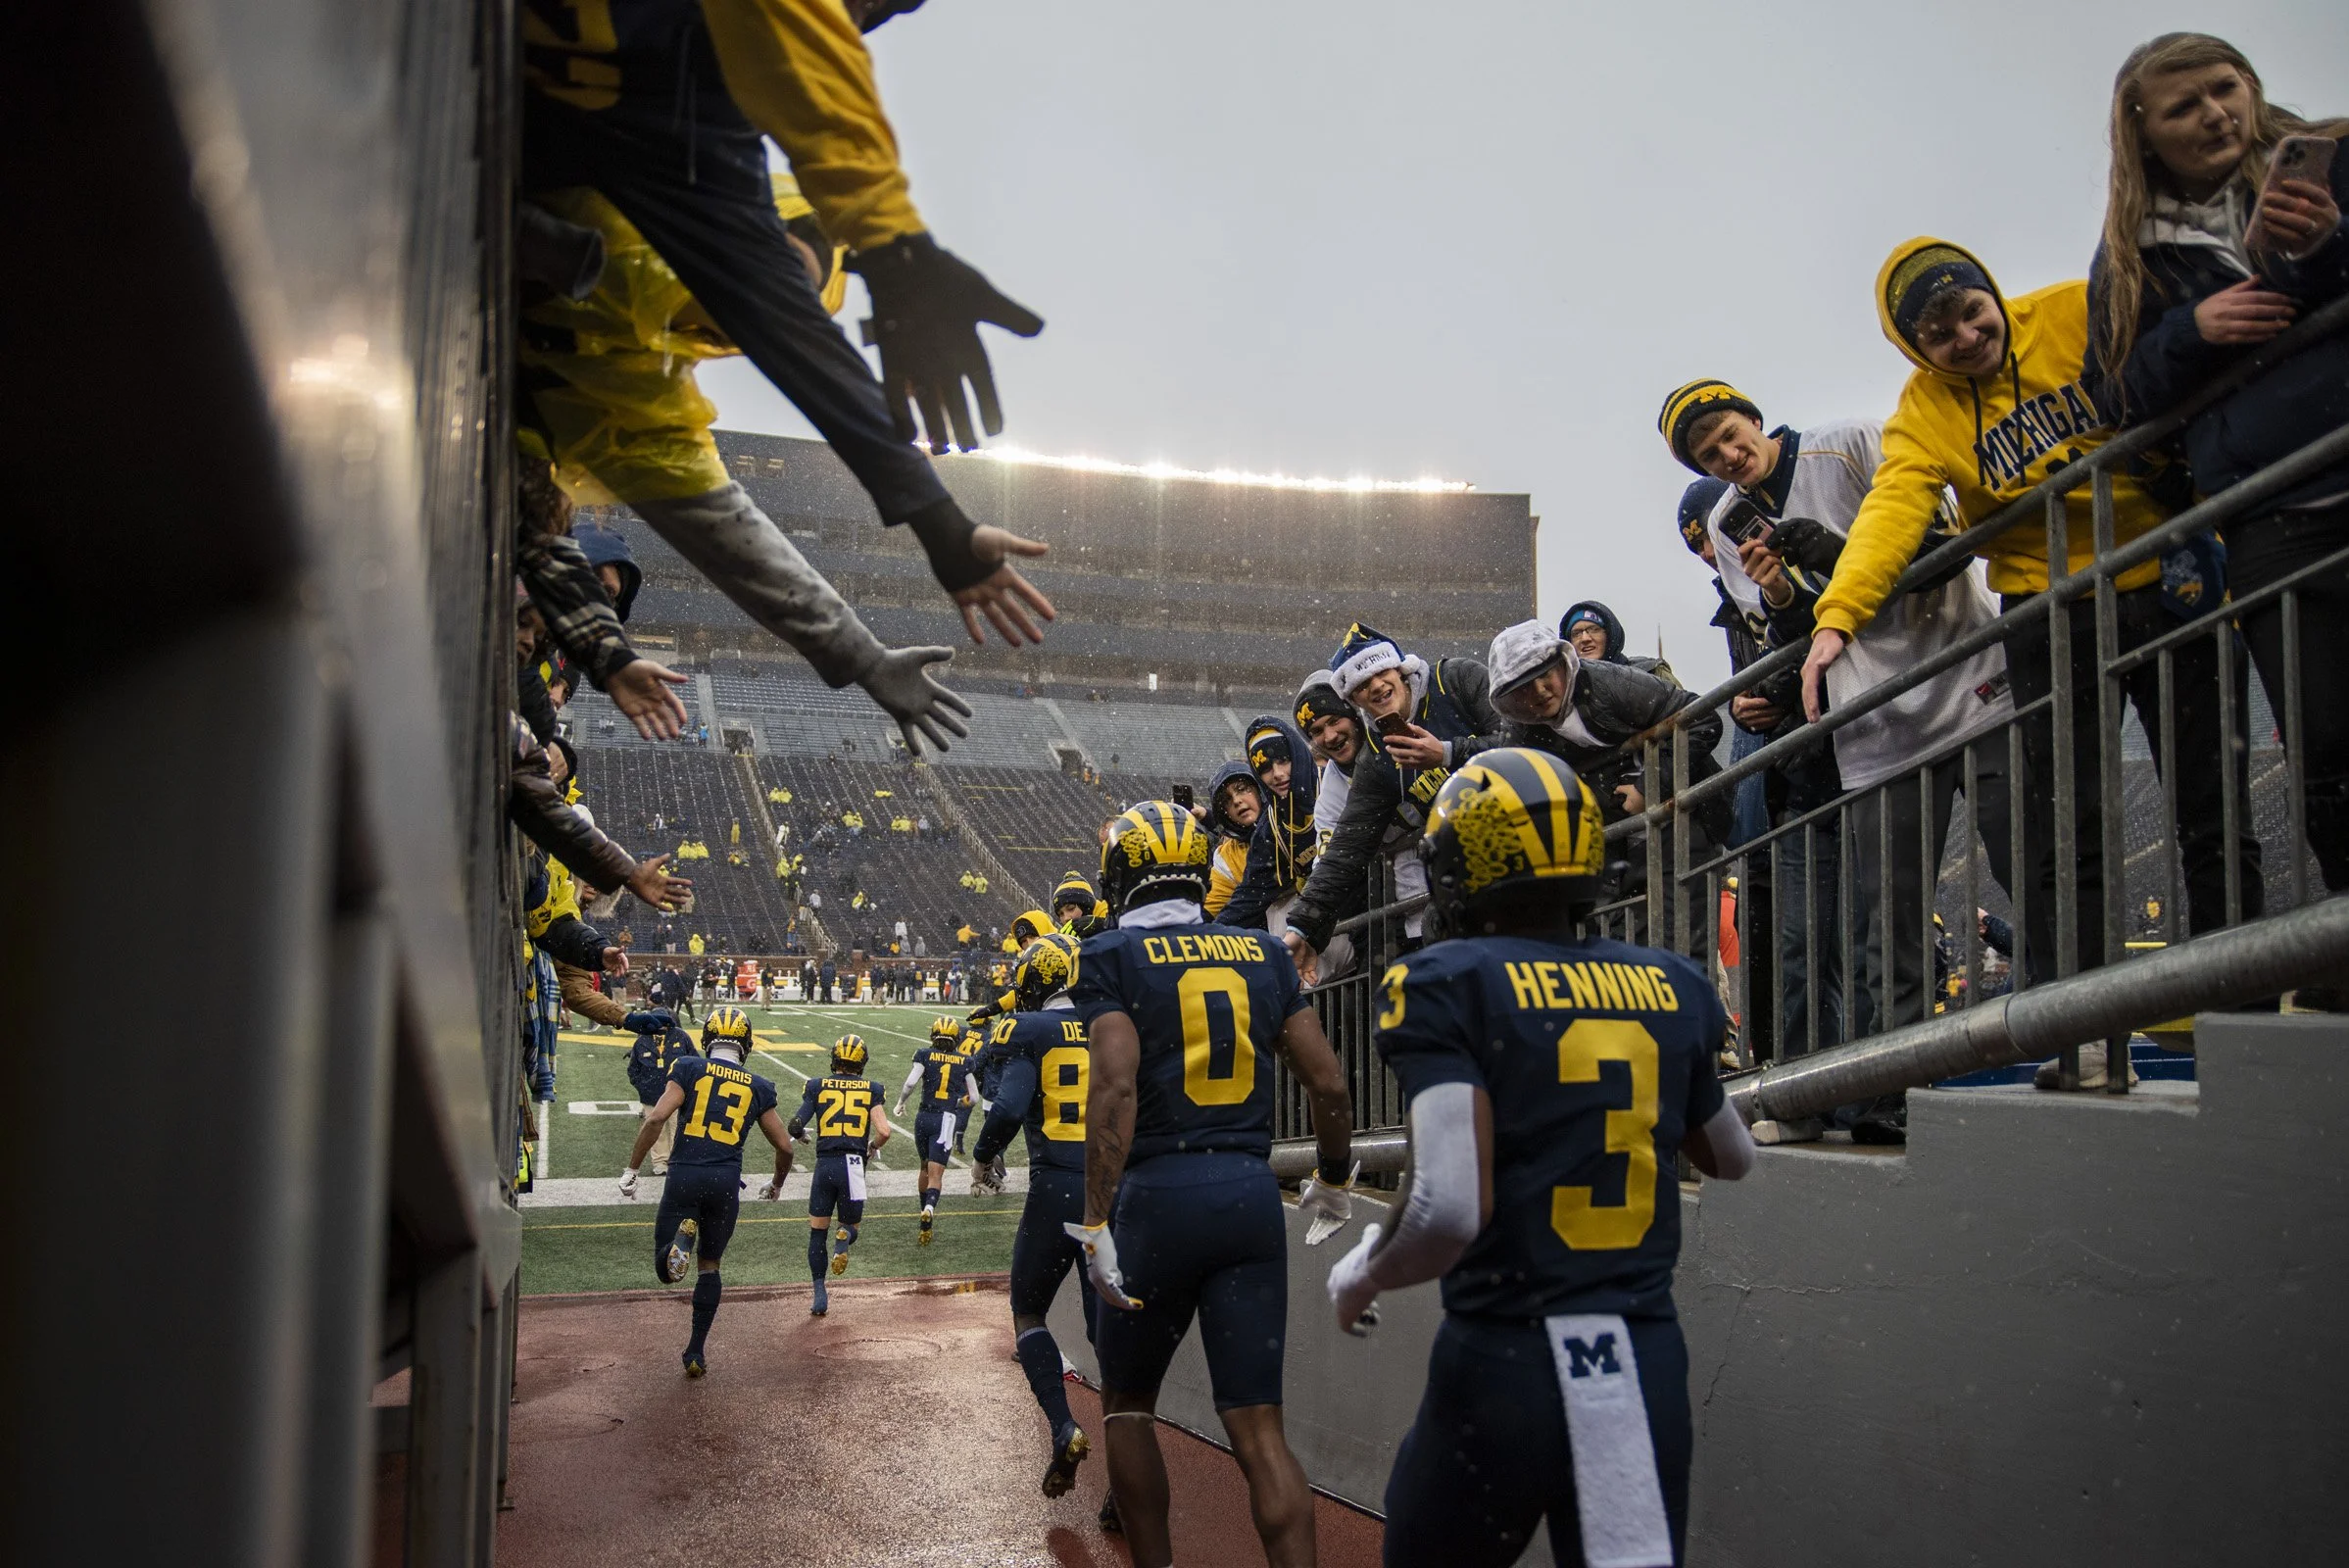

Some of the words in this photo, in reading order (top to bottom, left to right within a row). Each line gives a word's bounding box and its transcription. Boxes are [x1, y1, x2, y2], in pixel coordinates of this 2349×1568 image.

[1683, 518, 1703, 542] M
[1297, 702, 1314, 728] M
[1251, 749, 1267, 768] M
[1143, 934, 1265, 964] CLEMONS
[925, 992, 936, 1001] M
[1378, 963, 1409, 1030] 3
[1504, 961, 1679, 1011] HENNING
[1060, 1021, 1090, 1042] DE
[1177, 966, 1257, 1106] 0
[706, 1061, 753, 1085] MORRIS
[929, 1053, 965, 1064] ANTHONY
[821, 1079, 870, 1089] PETERSON
[935, 1063, 951, 1100] 1
[683, 1075, 754, 1146] 13
[818, 1090, 871, 1137] 25
[1550, 1018, 1659, 1250] 3
[1563, 1333, 1622, 1380] M
